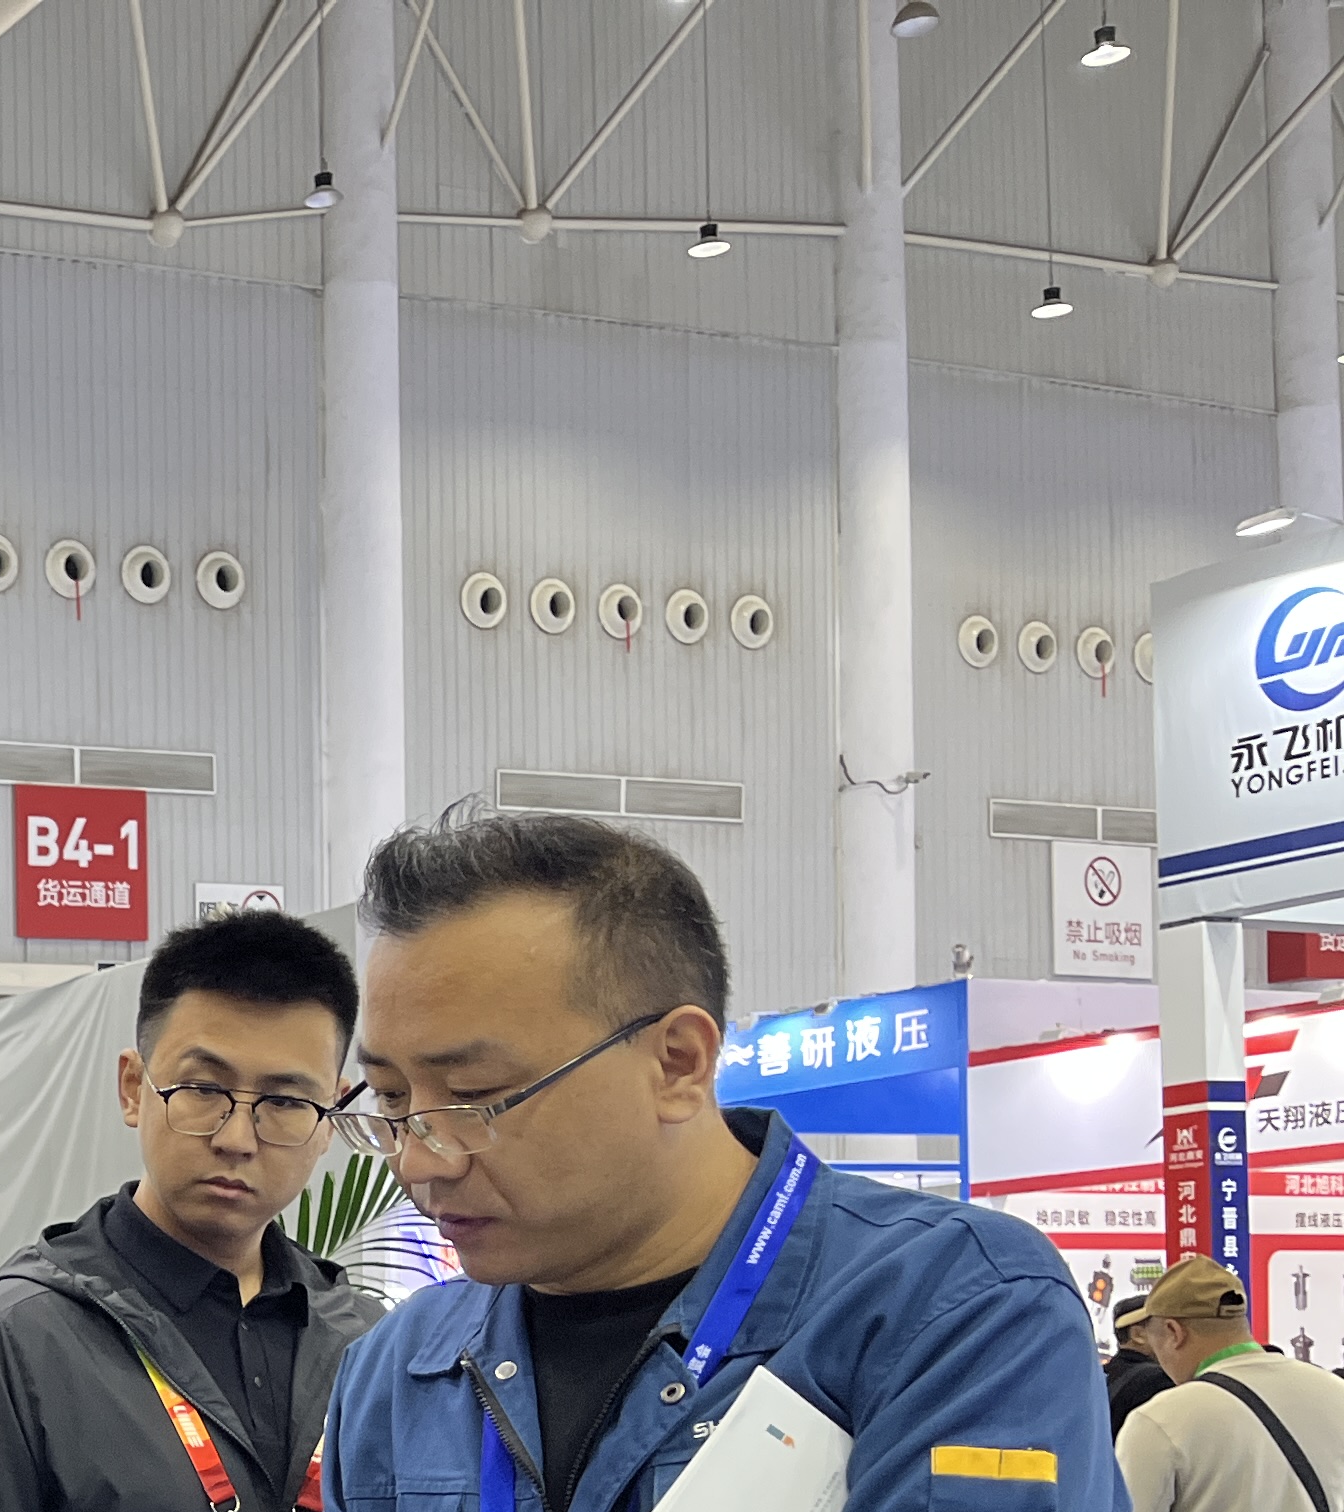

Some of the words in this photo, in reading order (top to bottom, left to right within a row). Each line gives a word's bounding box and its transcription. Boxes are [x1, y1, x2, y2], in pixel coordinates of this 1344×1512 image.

[1231, 755, 1344, 798] YONGFEI
[26, 815, 139, 870] B4-1
[36, 878, 132, 910] 货运通道
[1065, 919, 1143, 948] 禁止吸烟
[1072, 949, 1088, 962] No
[1092, 951, 1136, 966] Smoking
[756, 1008, 931, 1077] 善研液压
